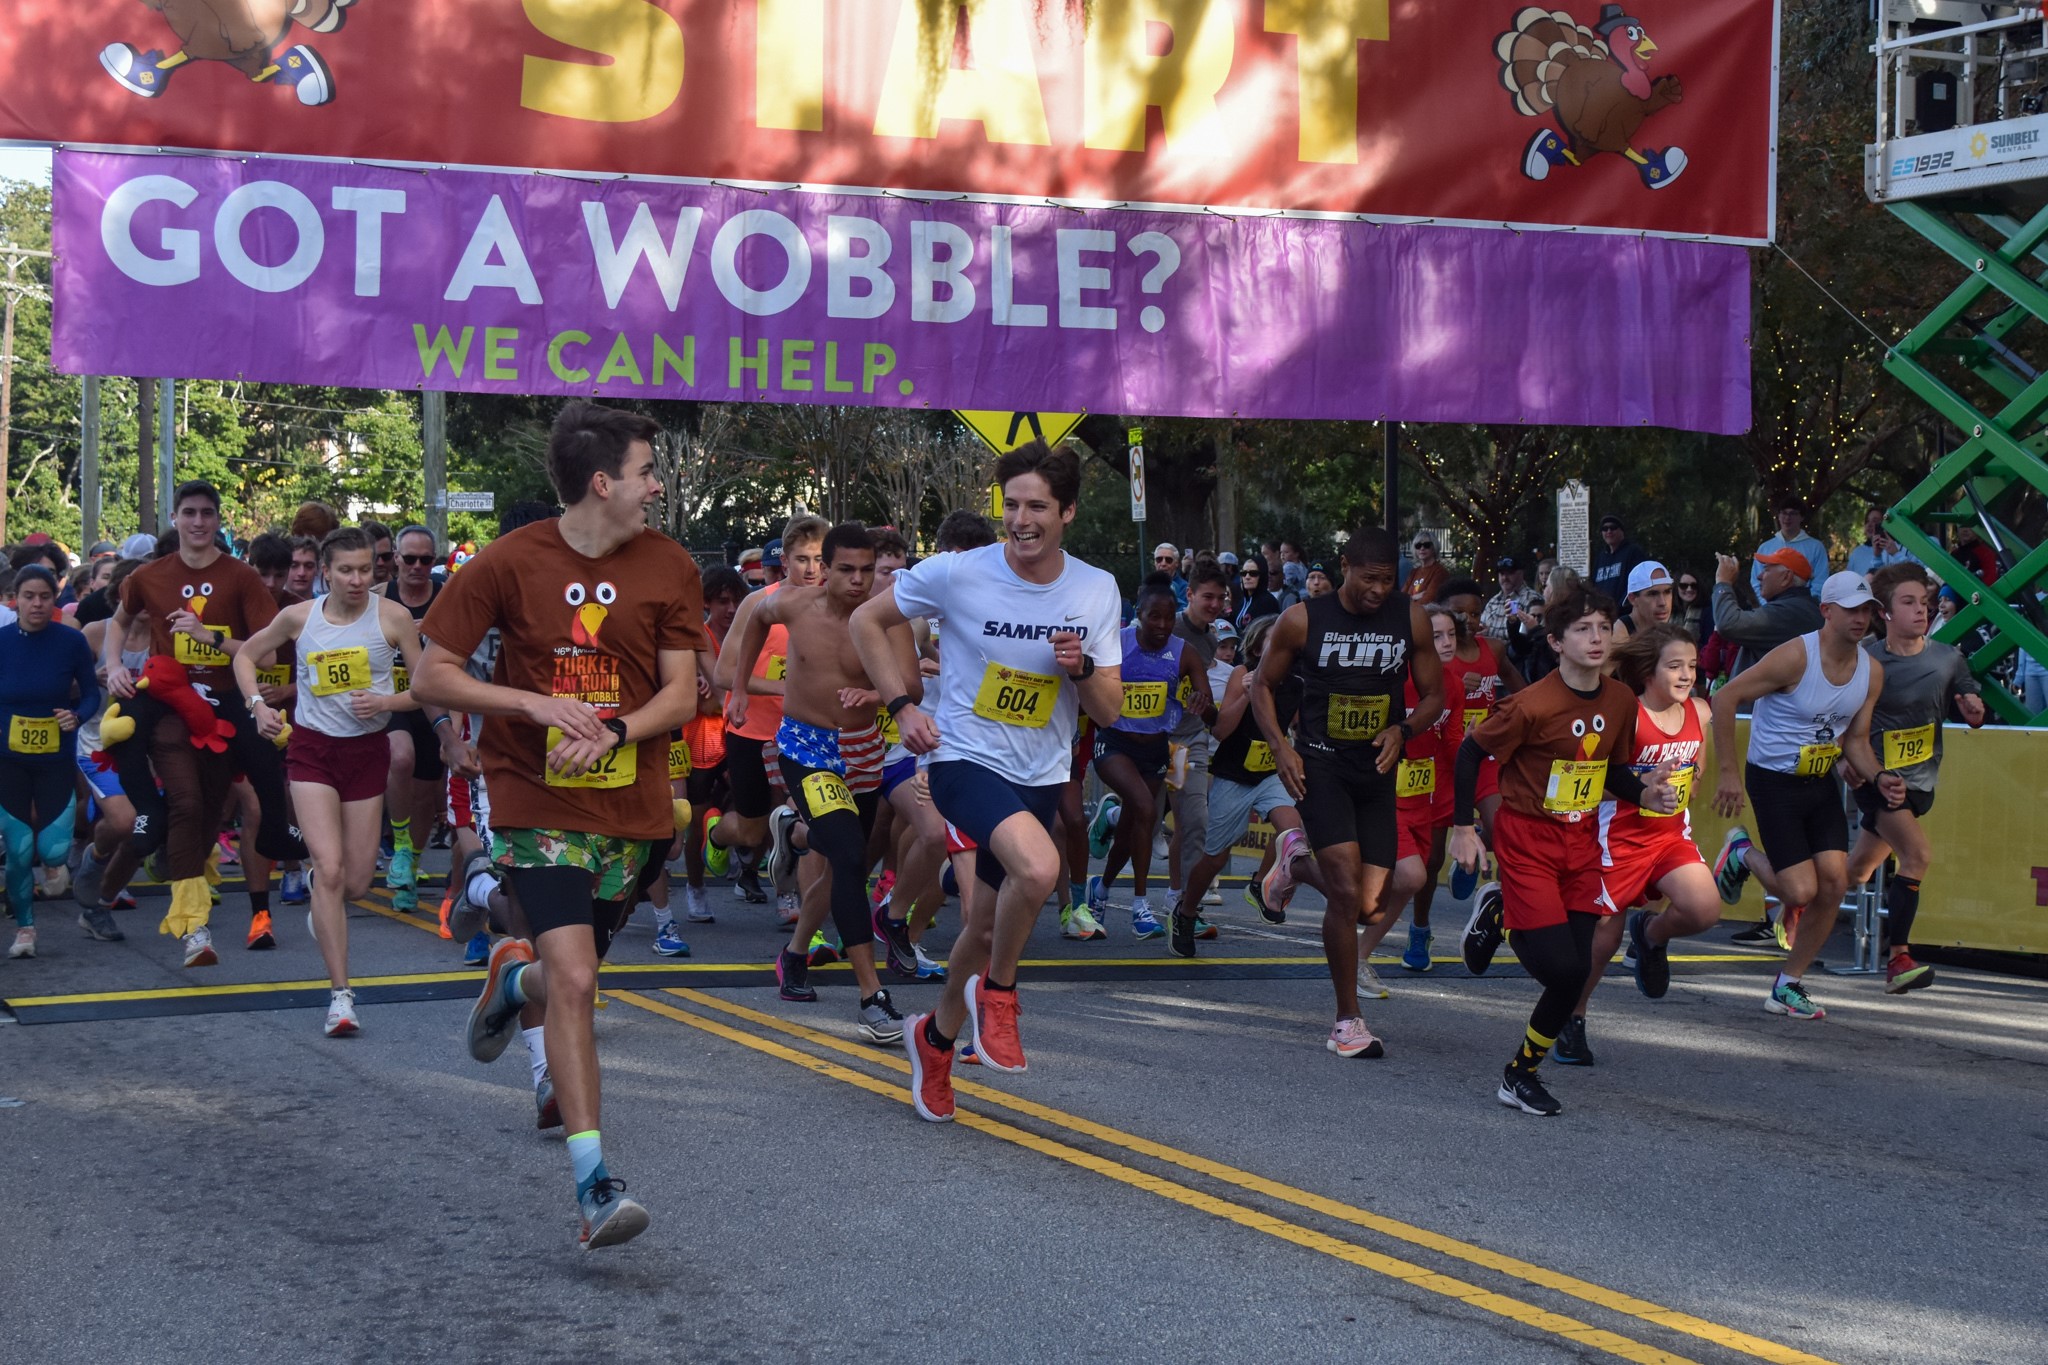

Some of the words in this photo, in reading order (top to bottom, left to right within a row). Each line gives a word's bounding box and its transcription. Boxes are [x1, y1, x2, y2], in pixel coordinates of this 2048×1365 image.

[520, 0, 1391, 165] START
[1991, 130, 2039, 149] SUNBELT
[1996, 144, 2032, 154] RENTALS
[1891, 151, 1954, 176] ES1932
[101, 174, 406, 297] GOT
[443, 194, 543, 305] A
[581, 201, 1181, 334] WOBBLE?
[413, 323, 518, 380] WE
[547, 330, 695, 387] CAN
[728, 337, 914, 396] HELP.
[451, 500, 484, 508] Charlotte
[1318, 642, 1392, 667] run
[328, 663, 350, 684] 58
[554, 655, 619, 675] TURKEY
[552, 676, 578, 692] DAY
[581, 674, 610, 691] RUN
[587, 691, 620, 702] WOBBLE
[996, 686, 1039, 715] 604
[1126, 693, 1160, 710] 1307
[1340, 710, 1380, 730] 1045
[21, 729, 48, 746] 928
[1636, 744, 1660, 763] MT.
[1897, 738, 1924, 759] 792
[1408, 769, 1431, 788] 378
[1573, 778, 1592, 800] 14
[1676, 784, 1686, 804] 5
